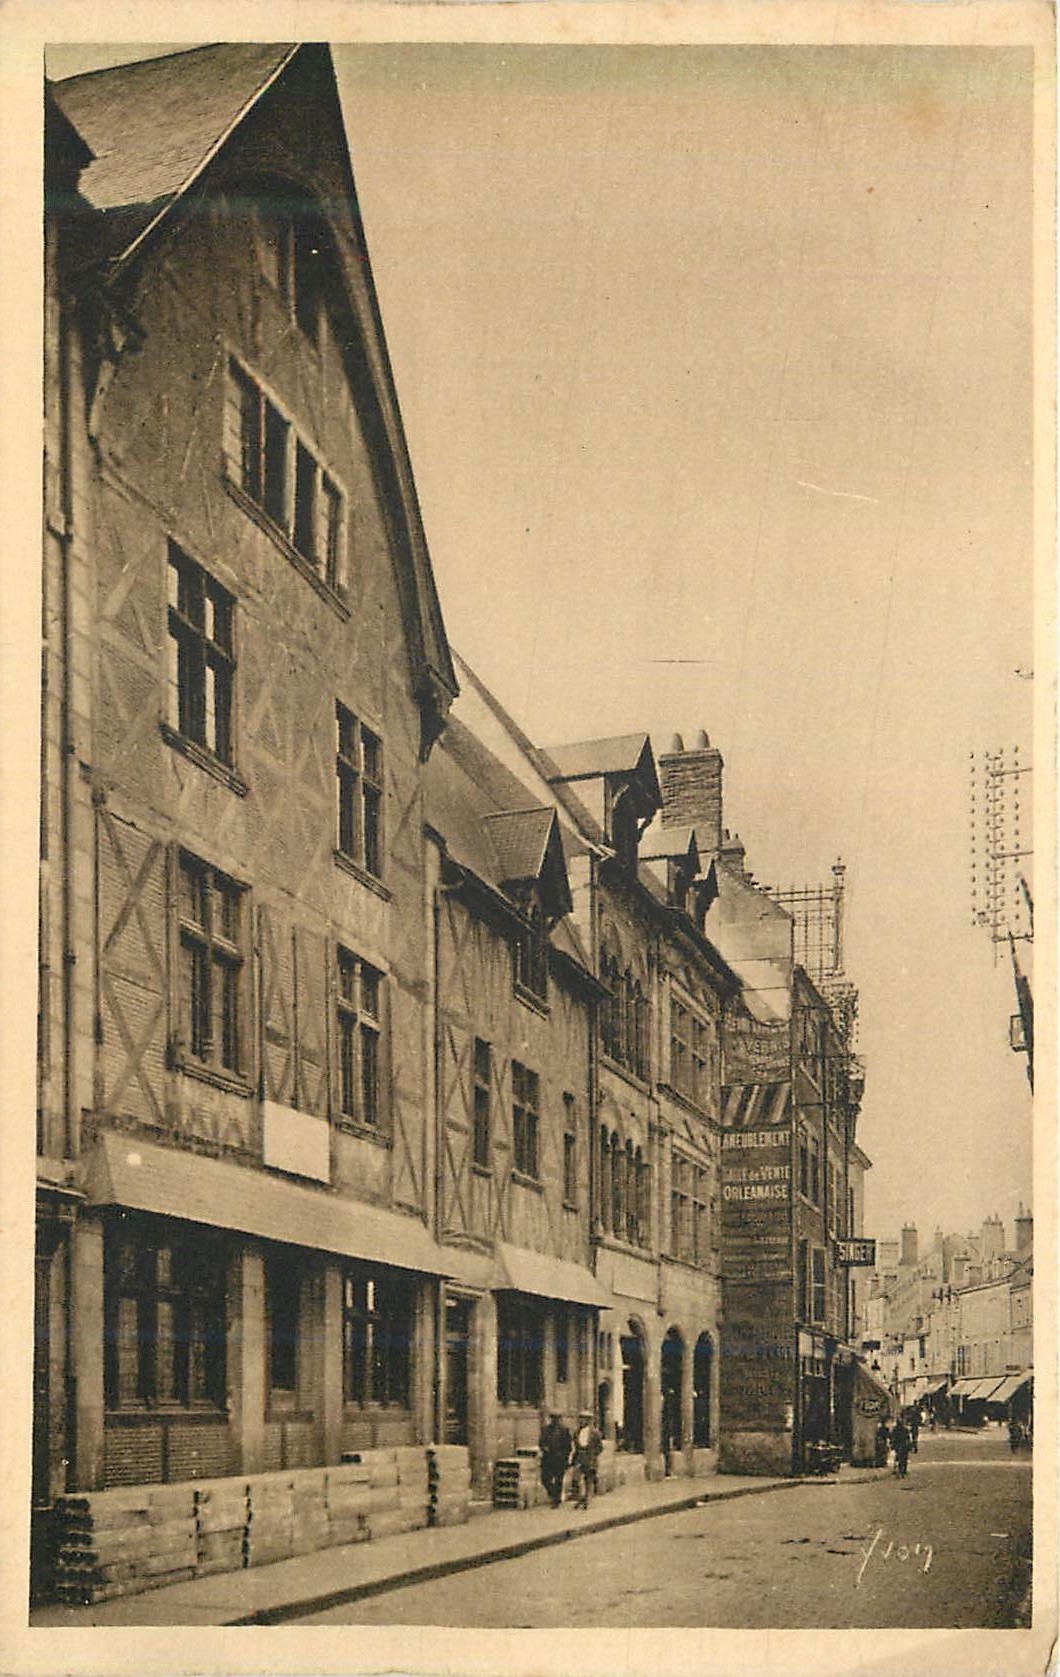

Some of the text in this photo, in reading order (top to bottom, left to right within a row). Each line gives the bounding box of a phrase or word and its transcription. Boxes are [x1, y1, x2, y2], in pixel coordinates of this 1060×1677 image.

[757, 1164, 790, 1180] VENTE
[723, 1182, 788, 1200] ORLEANAISE
[837, 1241, 871, 1260] SINGER
